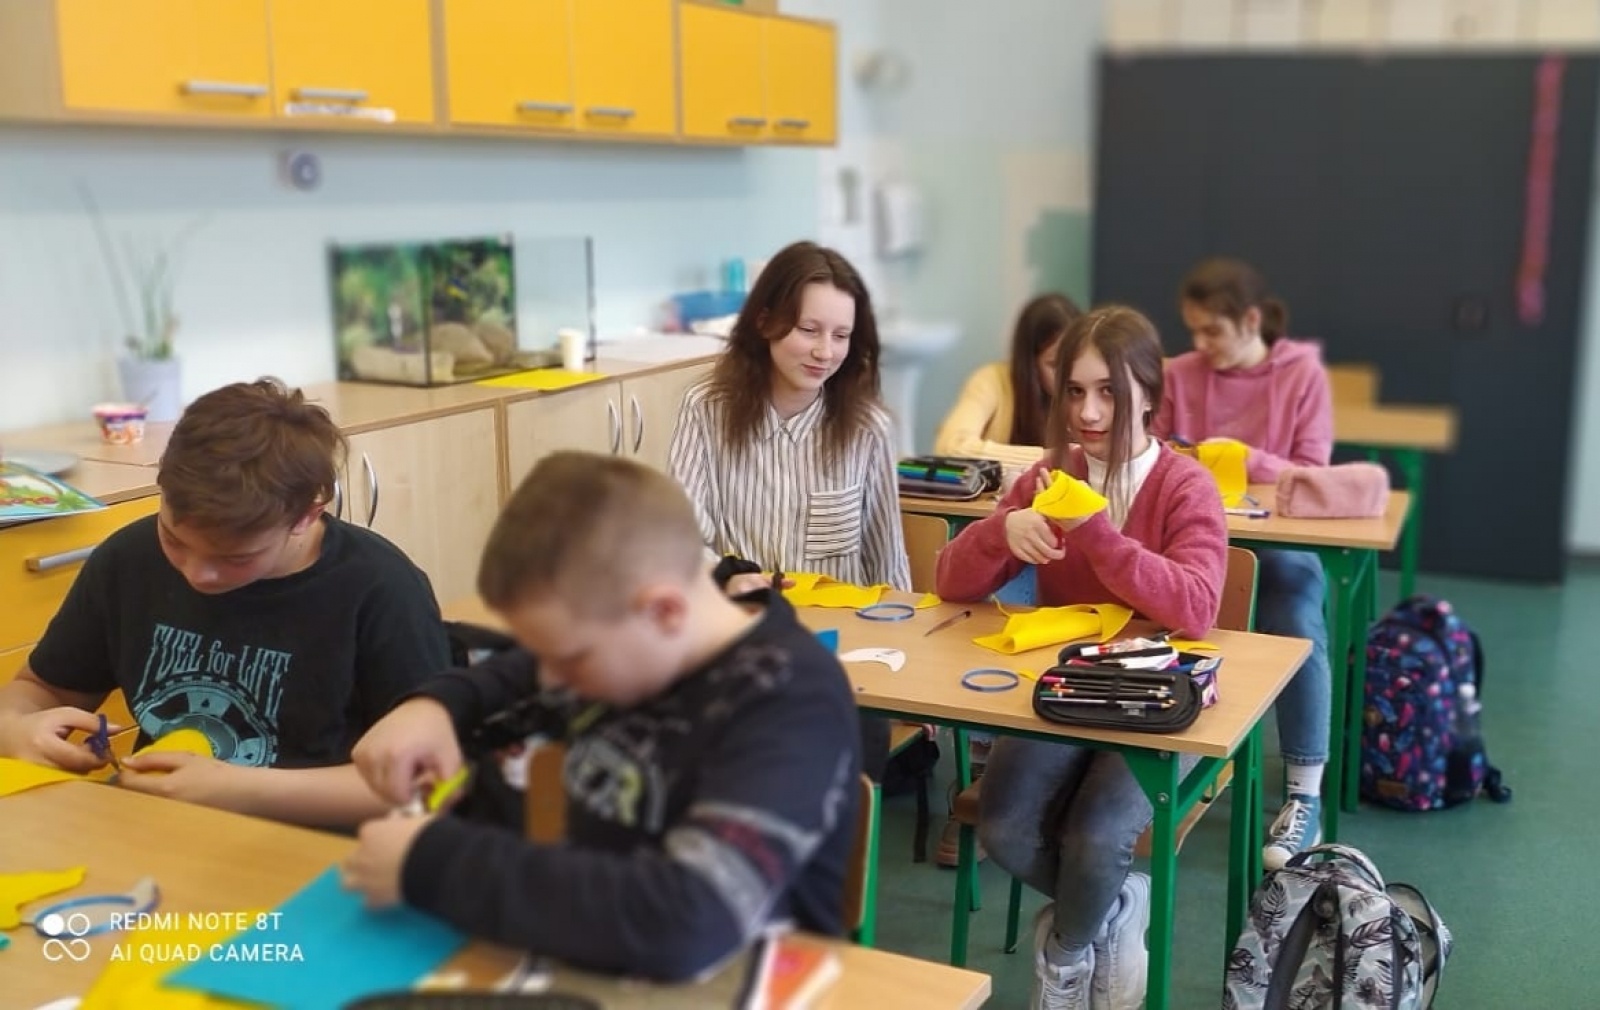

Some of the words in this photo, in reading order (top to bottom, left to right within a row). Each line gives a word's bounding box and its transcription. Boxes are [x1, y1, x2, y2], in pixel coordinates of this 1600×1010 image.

[134, 623, 204, 699] FUEL
[206, 640, 236, 677] for
[237, 645, 293, 729] LIFE
